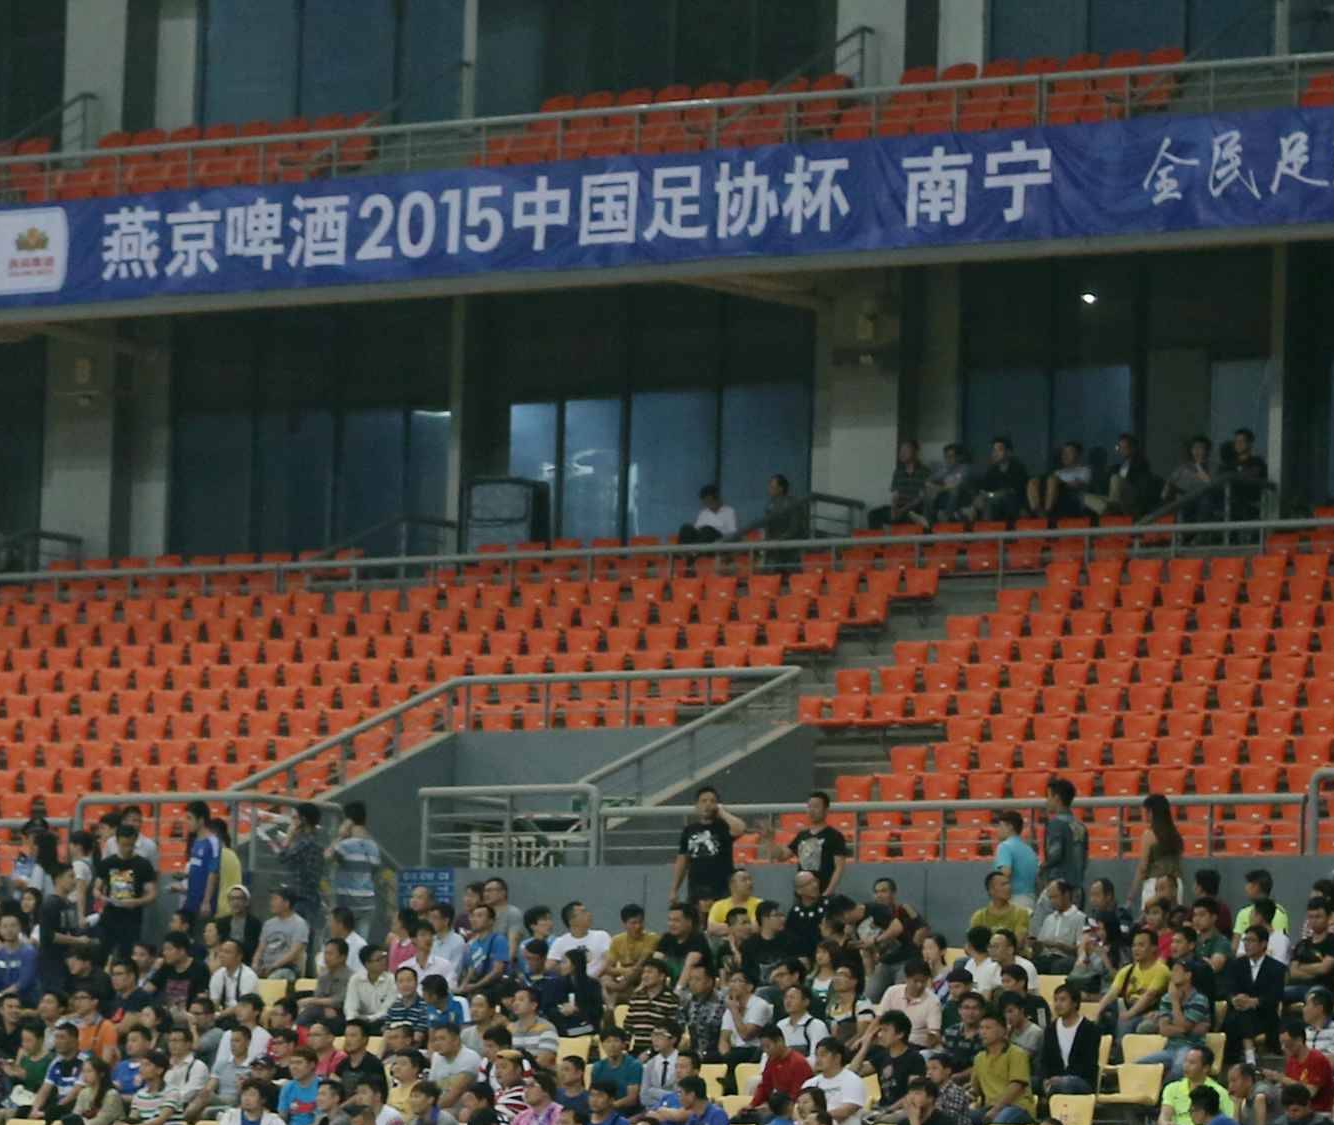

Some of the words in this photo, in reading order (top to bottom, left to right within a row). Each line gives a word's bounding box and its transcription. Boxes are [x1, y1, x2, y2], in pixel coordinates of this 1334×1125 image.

[102, 155, 850, 281] 燕京啤酒2015中国足协杯
[902, 141, 1053, 228] 南宁
